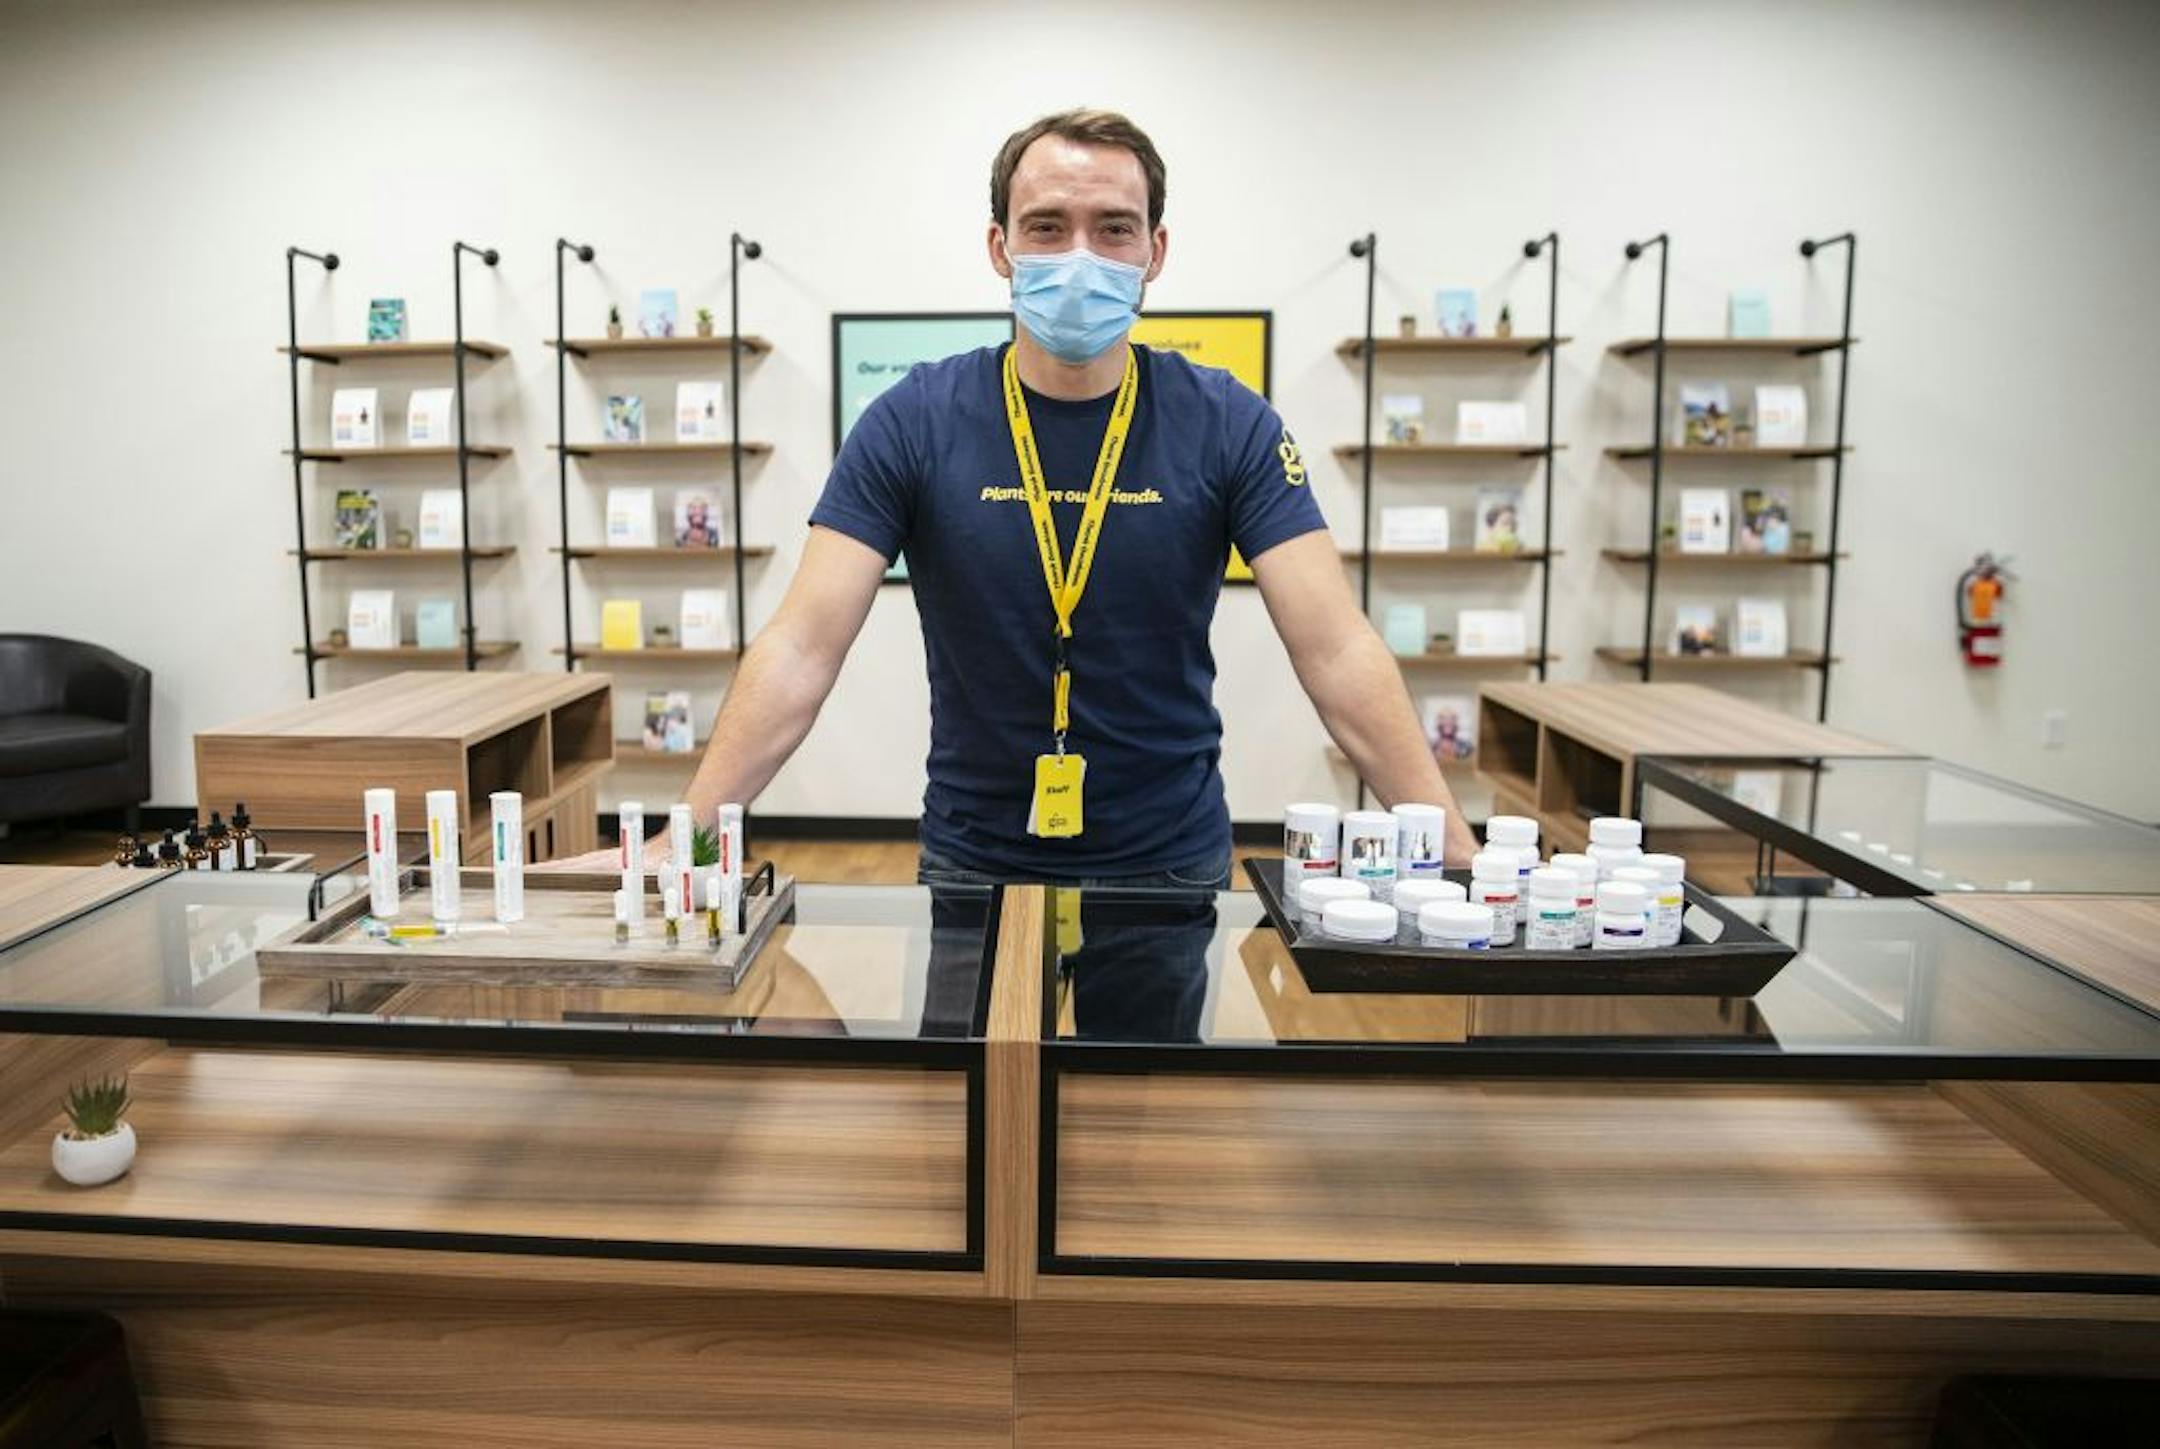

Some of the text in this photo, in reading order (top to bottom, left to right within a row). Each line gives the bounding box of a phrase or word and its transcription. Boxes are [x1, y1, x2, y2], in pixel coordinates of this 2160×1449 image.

[981, 486, 1164, 505] Plant re ou riends.
